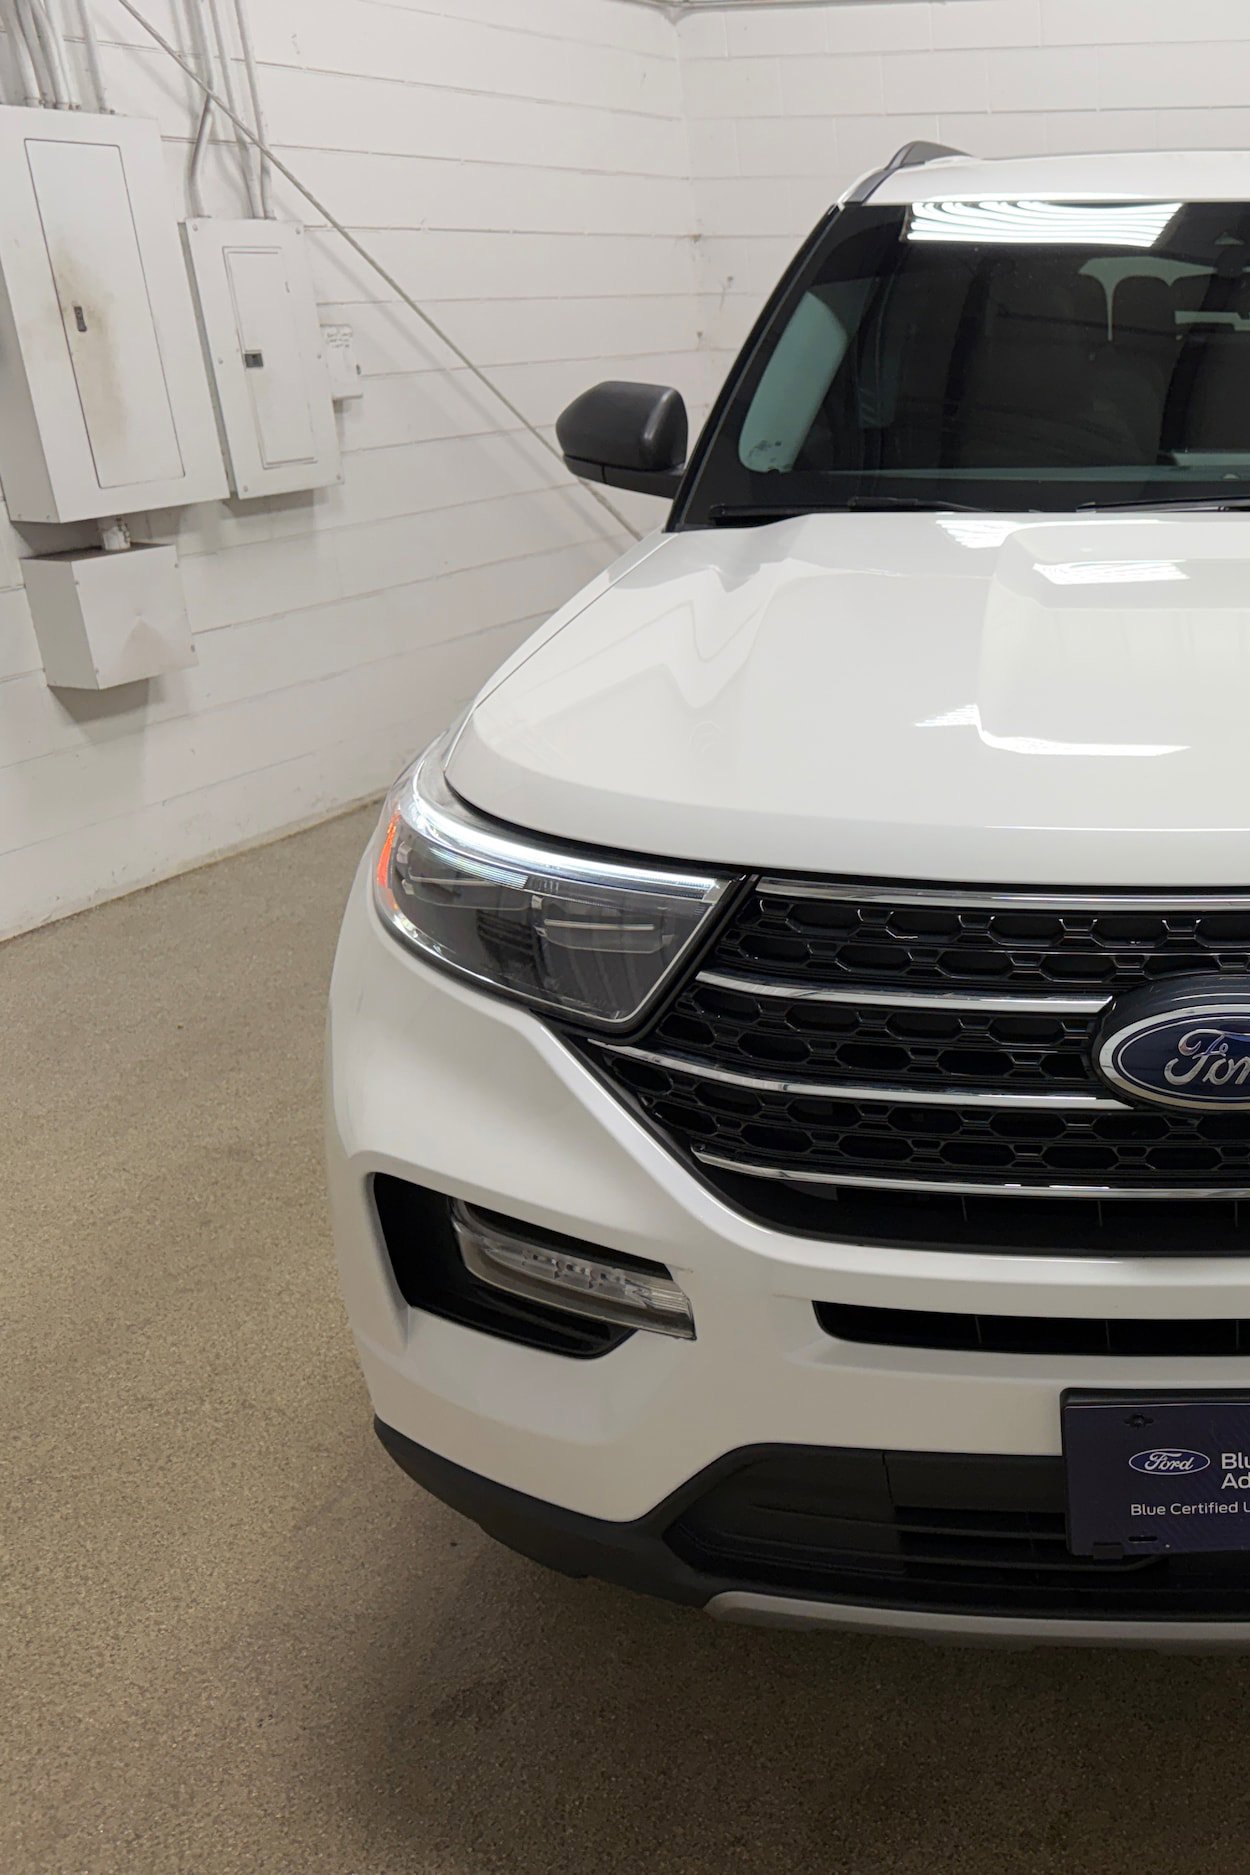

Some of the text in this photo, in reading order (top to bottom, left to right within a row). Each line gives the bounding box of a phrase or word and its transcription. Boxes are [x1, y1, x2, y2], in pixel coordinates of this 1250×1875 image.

[1144, 1451, 1195, 1472] Ford
[1130, 1502, 1167, 1516] Blue
[1169, 1501, 1239, 1515] Certified
